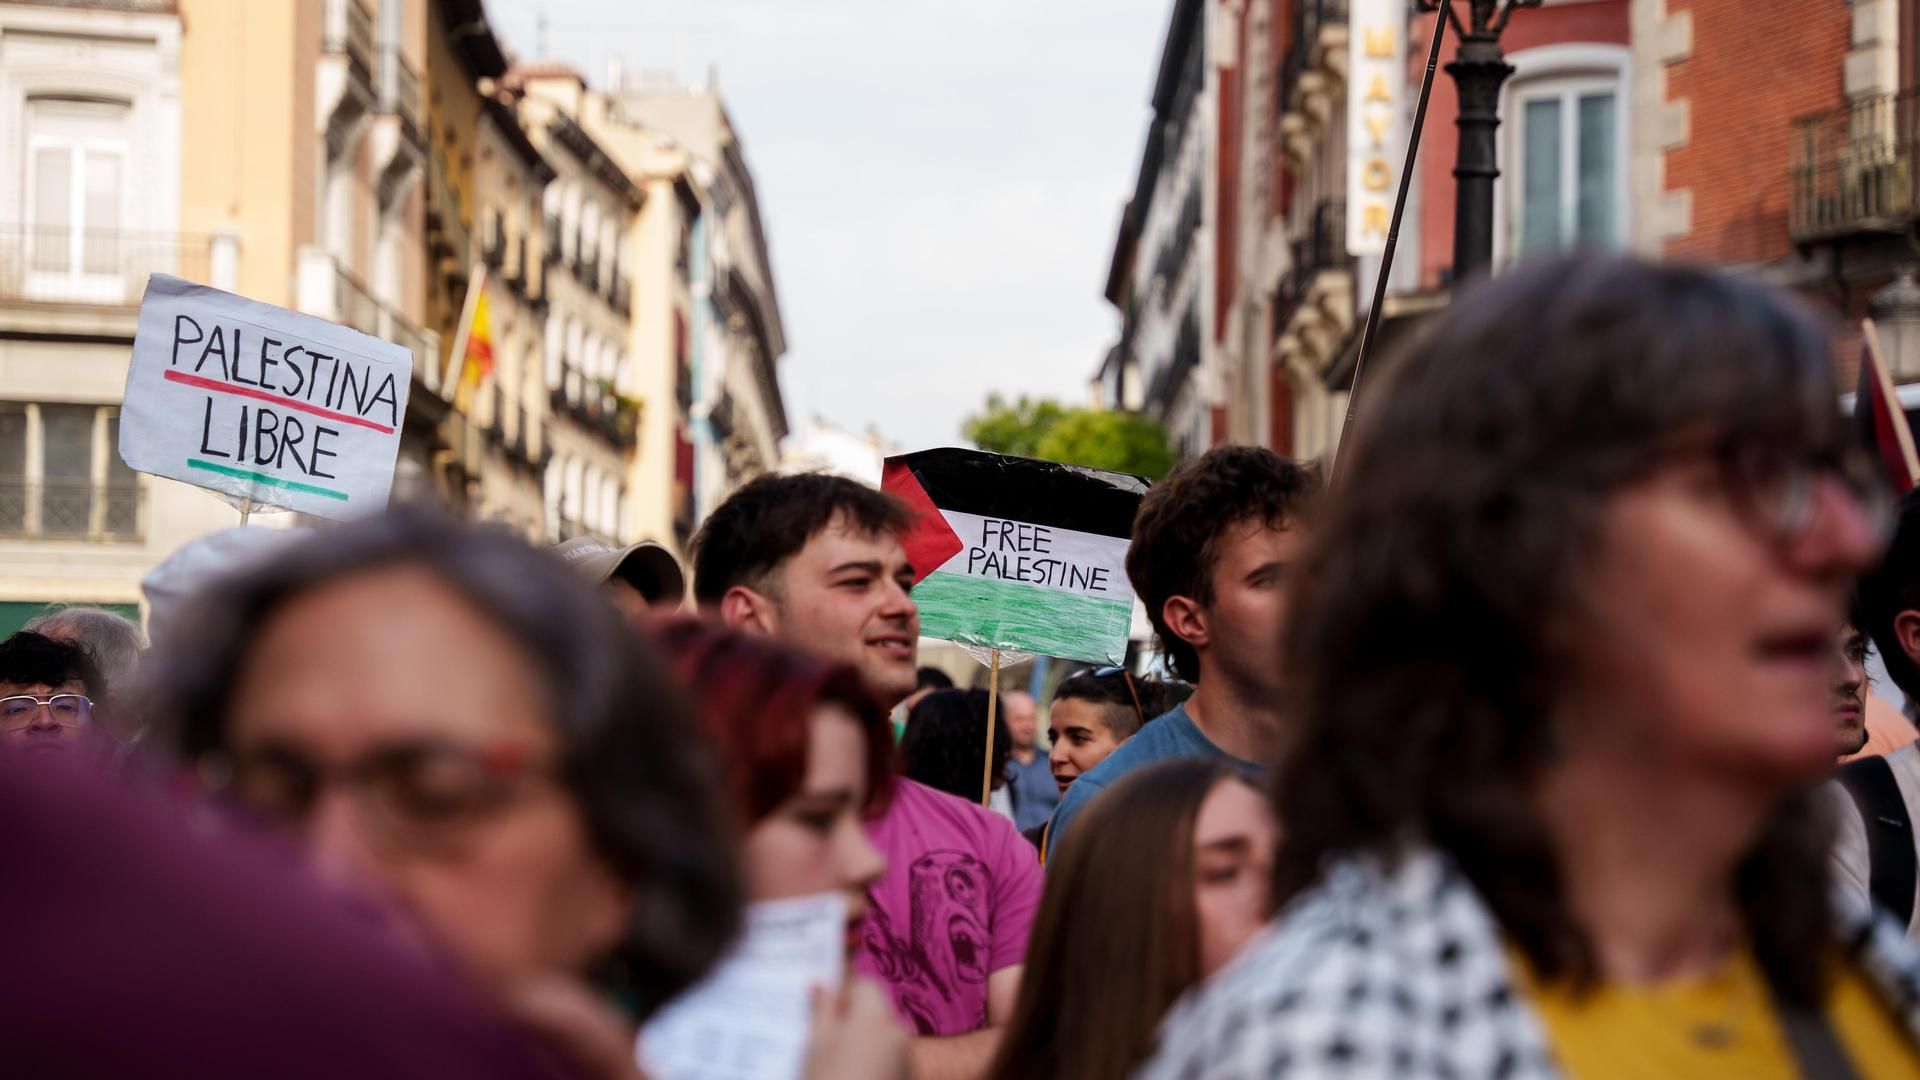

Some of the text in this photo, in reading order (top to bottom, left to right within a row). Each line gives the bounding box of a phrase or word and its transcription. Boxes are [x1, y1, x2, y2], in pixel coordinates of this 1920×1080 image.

[1362, 25, 1397, 238] MAYOR
[172, 314, 397, 427] PALESTINA
[200, 396, 339, 479] LIBRE
[967, 546, 1110, 591] PALESTINE
[982, 519, 1052, 553] FREE
